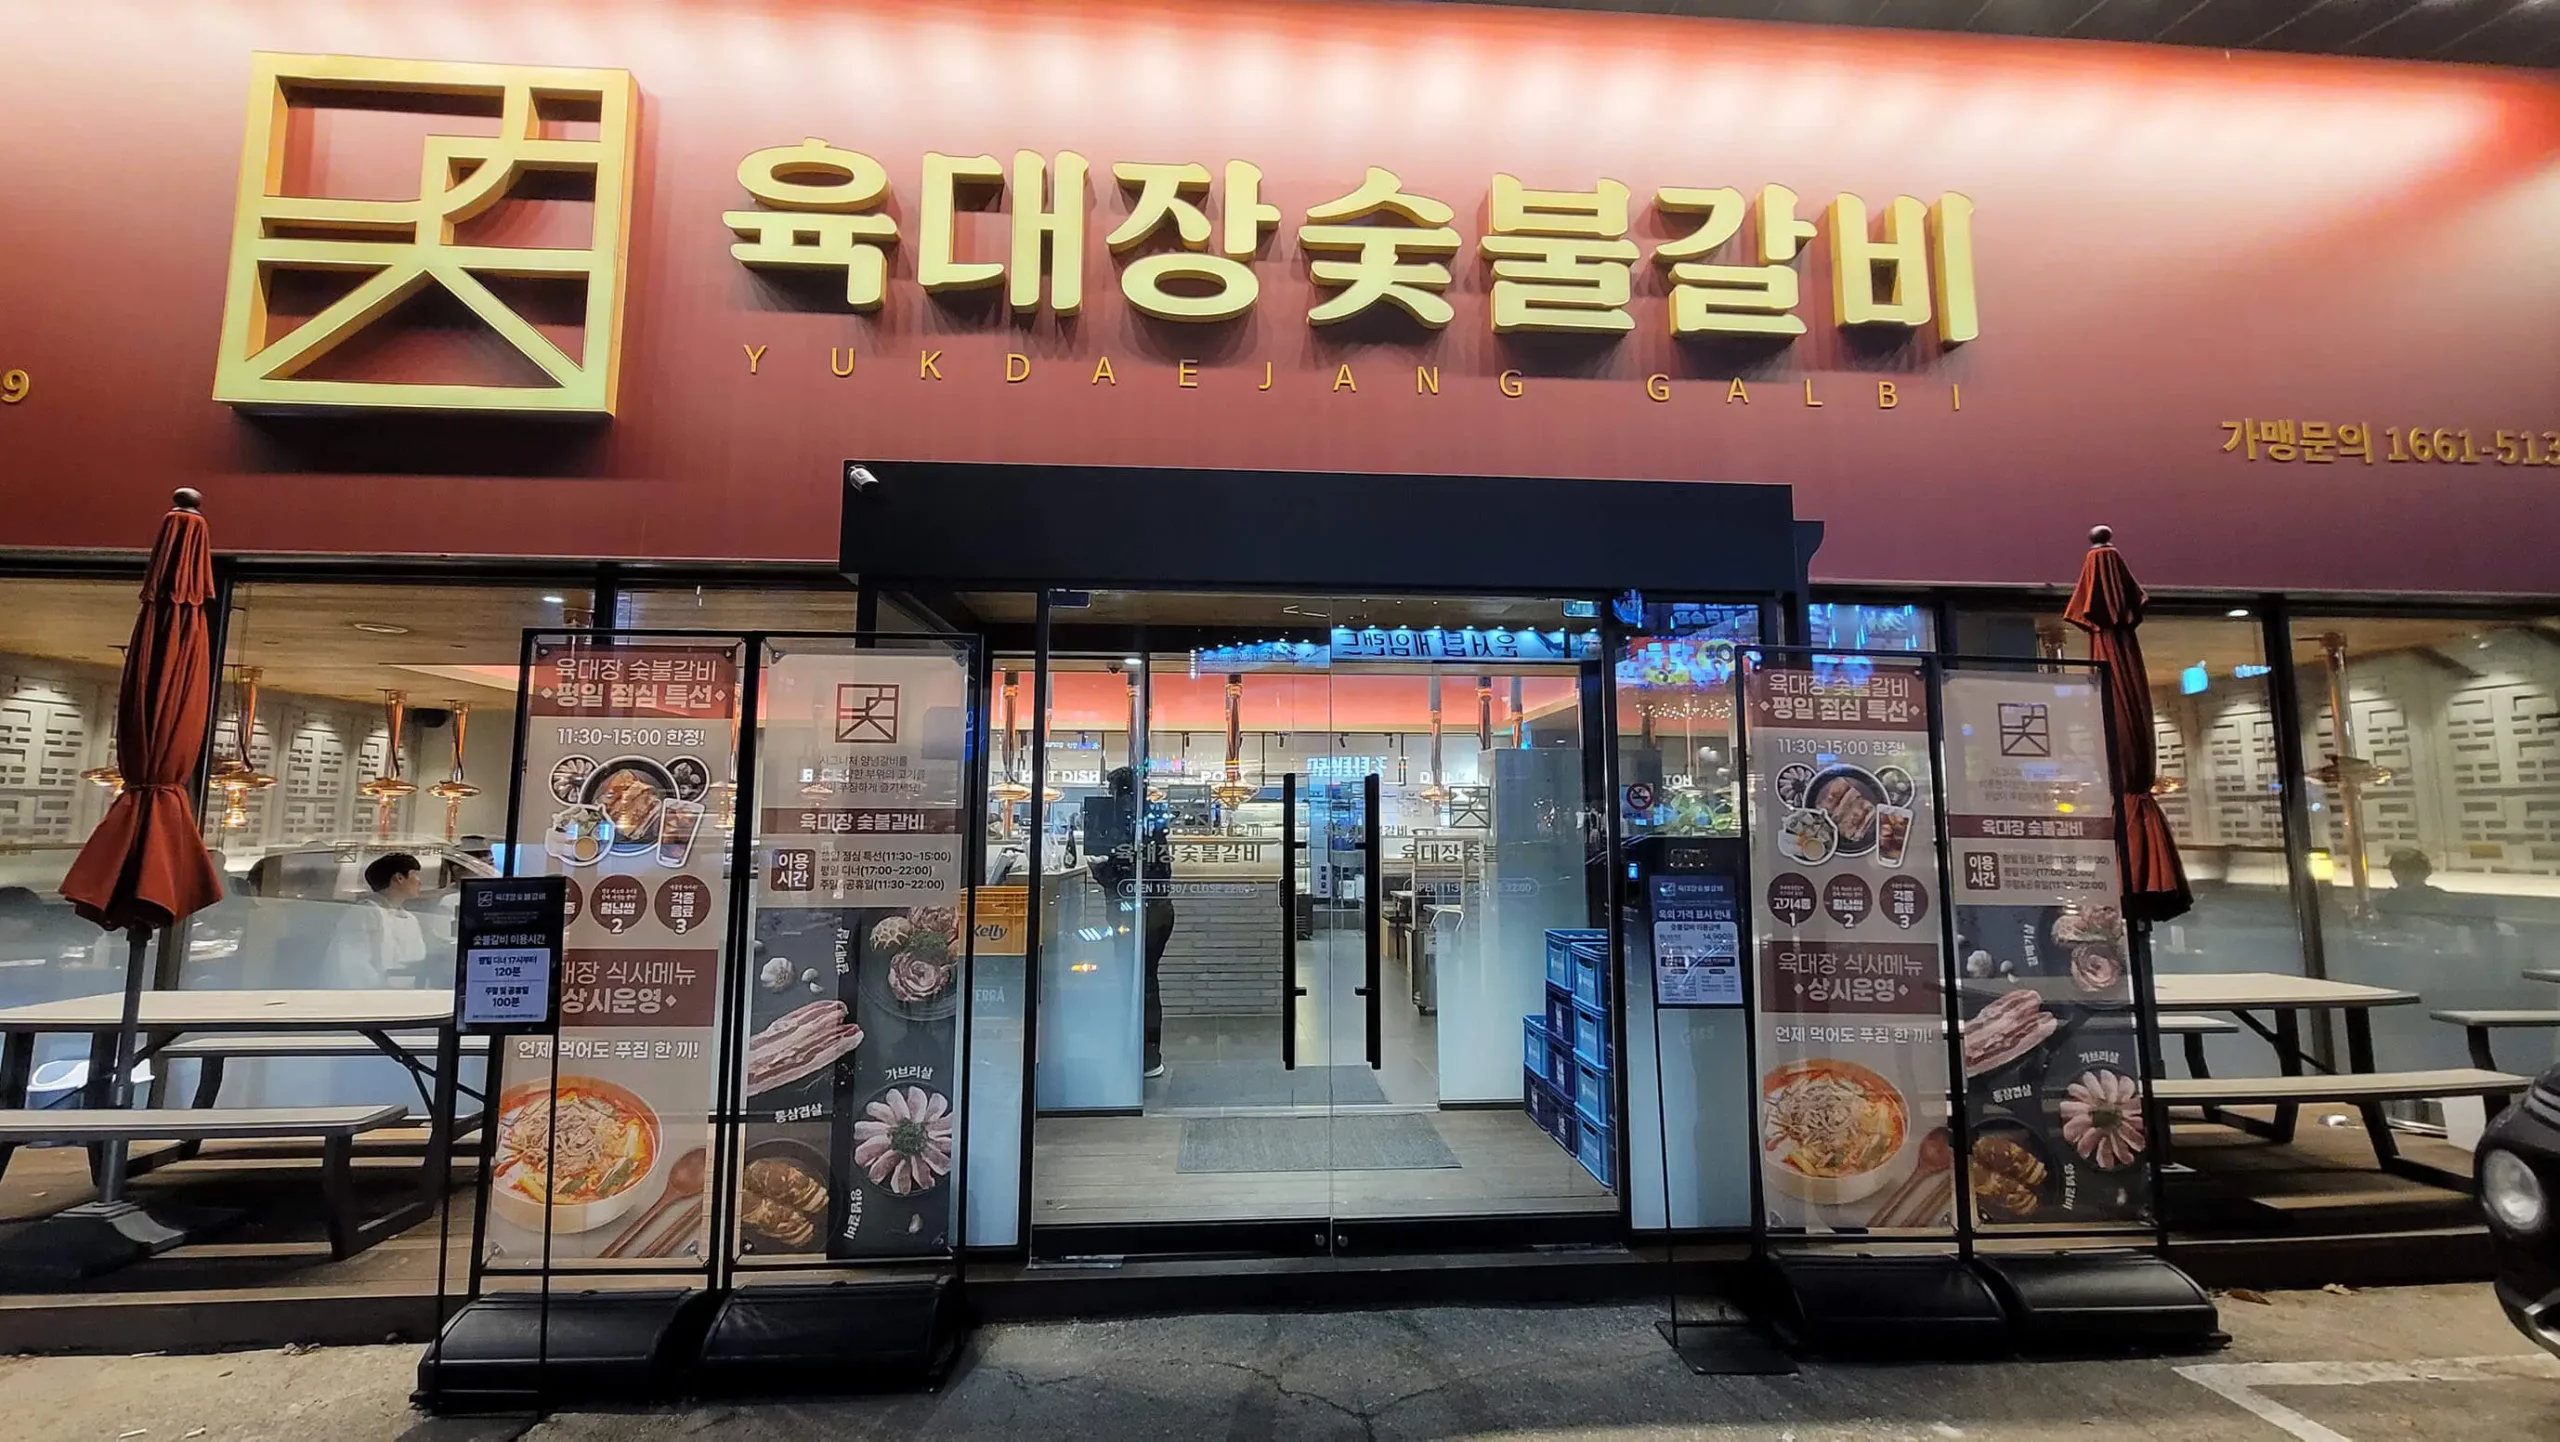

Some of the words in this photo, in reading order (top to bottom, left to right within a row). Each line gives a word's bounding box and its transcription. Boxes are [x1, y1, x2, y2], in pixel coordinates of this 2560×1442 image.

[722, 137, 1979, 343] 육대장숯불갈비
[743, 343, 1523, 397] YUKDAEJANG
[1646, 373, 1961, 411] GALBI
[2221, 417, 2374, 465] 가맹문의
[556, 657, 623, 681] 육대장
[629, 660, 717, 682] 숯불갈비
[1769, 673, 1827, 696] 육대장
[1833, 677, 1909, 698] 숯불갈비
[556, 683, 603, 707] 평일
[611, 684, 658, 708] 점심
[665, 685, 712, 709] 특선
[1773, 697, 1814, 719] 평일
[1820, 698, 1861, 721] 점심
[1866, 700, 1909, 723] 특선
[557, 728, 661, 745] 11:30~15:00
[666, 729, 705, 746] 한정!
[1777, 738, 1868, 755] 11:30~15:00
[1062, 769, 1101, 783] DISH
[800, 813, 853, 832] 육대장
[857, 813, 925, 831] 숯불갈비
[1981, 819, 2025, 836] 육대장
[2028, 820, 2084, 837] 숯불갈비
[779, 853, 810, 870] 이용
[843, 851, 861, 862] 점심
[864, 851, 952, 863] 특선(11:30~15:00)
[1116, 843, 1260, 863] 육대장숯불갈비
[1402, 843, 1498, 863] 육대장숯불
[842, 865, 933, 877] 디너(17:00~22:00)
[1969, 855, 1995, 871] 이용
[777, 870, 810, 888] 시간
[1971, 872, 1996, 887] 시간
[1678, 910, 1694, 920] 가격
[1789, 912, 1797, 927] 1
[1843, 913, 1854, 928] 2
[1900, 915, 1910, 929] 3
[611, 918, 622, 933] 2
[676, 918, 687, 933] 3
[510, 933, 546, 945] 이용시간
[835, 927, 850, 975] 갈매기살
[494, 966, 522, 977] 120분
[606, 961, 697, 985] 식사메뉴
[1778, 952, 1837, 975] 육대장
[1844, 953, 1924, 977] 식사메뉴
[1808, 978, 1894, 1002] 상시운영
[493, 997, 520, 1008] 100분
[562, 987, 662, 1014] 상시운영
[1775, 1027, 1805, 1043] 언제
[1810, 1027, 1855, 1043] 먹어도
[1860, 1027, 1889, 1043] 푸짐
[1894, 1027, 1908, 1044] 한
[1913, 1028, 1933, 1044] 끼!
[518, 1040, 551, 1059] 언제
[559, 1040, 609, 1059] 먹어도
[615, 1041, 649, 1059] 푸짐
[654, 1041, 672, 1059] 한
[676, 1041, 699, 1060] 끼!
[2079, 1050, 2120, 1064] 가브리살
[884, 1065, 934, 1081] 가브리살
[843, 1188, 862, 1239] 양념갈비
